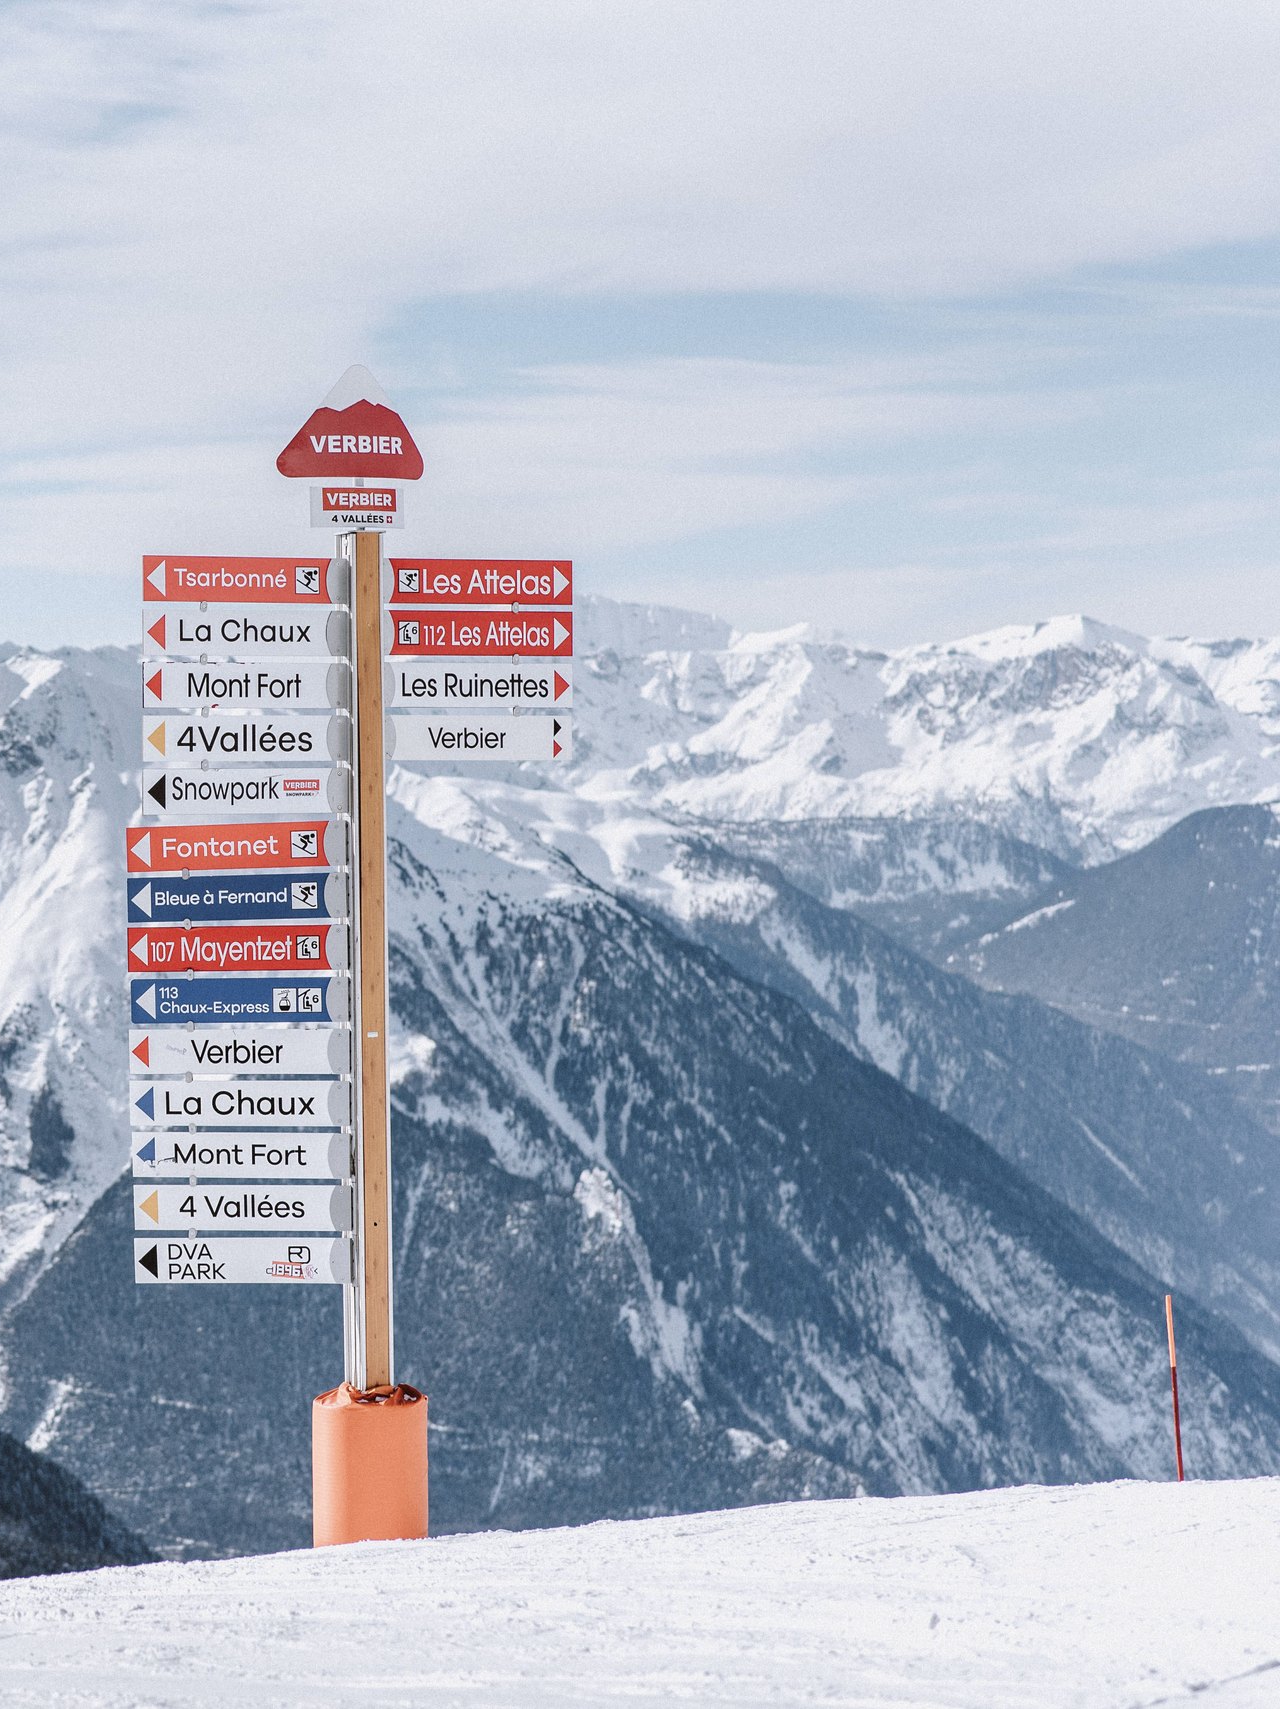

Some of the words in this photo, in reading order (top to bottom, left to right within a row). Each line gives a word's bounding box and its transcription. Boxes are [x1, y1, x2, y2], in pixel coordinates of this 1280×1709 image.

[309, 435, 403, 455] VERBIER
[326, 491, 393, 508] VERBIER
[331, 515, 339, 523] 4
[341, 513, 385, 524] VALLÉES
[173, 567, 287, 588] Tsarbonné
[422, 568, 462, 594] Les
[467, 569, 551, 595] Attelas
[179, 618, 212, 642] La
[220, 618, 311, 643] Chaux
[423, 625, 446, 646] 112
[451, 620, 481, 646] Les
[485, 621, 550, 647] Attelas
[187, 672, 251, 698] Mont
[257, 673, 302, 698] Fort
[401, 672, 438, 697] Les
[444, 672, 549, 698] Ruinettes
[427, 727, 507, 749] Verbier
[171, 776, 280, 806] Snowpark
[162, 835, 279, 858] Fontanet
[154, 891, 200, 906] Bleue
[203, 889, 215, 905] à
[218, 888, 288, 904] Fernand
[150, 941, 175, 962] 107
[180, 935, 293, 967] Mayentzet
[158, 987, 179, 999] 113
[160, 1001, 270, 1016] Chaux-Express
[190, 1039, 283, 1064] Verbier
[165, 1091, 202, 1115] La
[211, 1089, 315, 1116] Chaux
[173, 1143, 244, 1165] Mont
[251, 1144, 307, 1166] Fort
[179, 1195, 197, 1218] 4
[204, 1194, 306, 1218] Vallées
[167, 1243, 213, 1260] DVA
[168, 1262, 227, 1280] PARK
